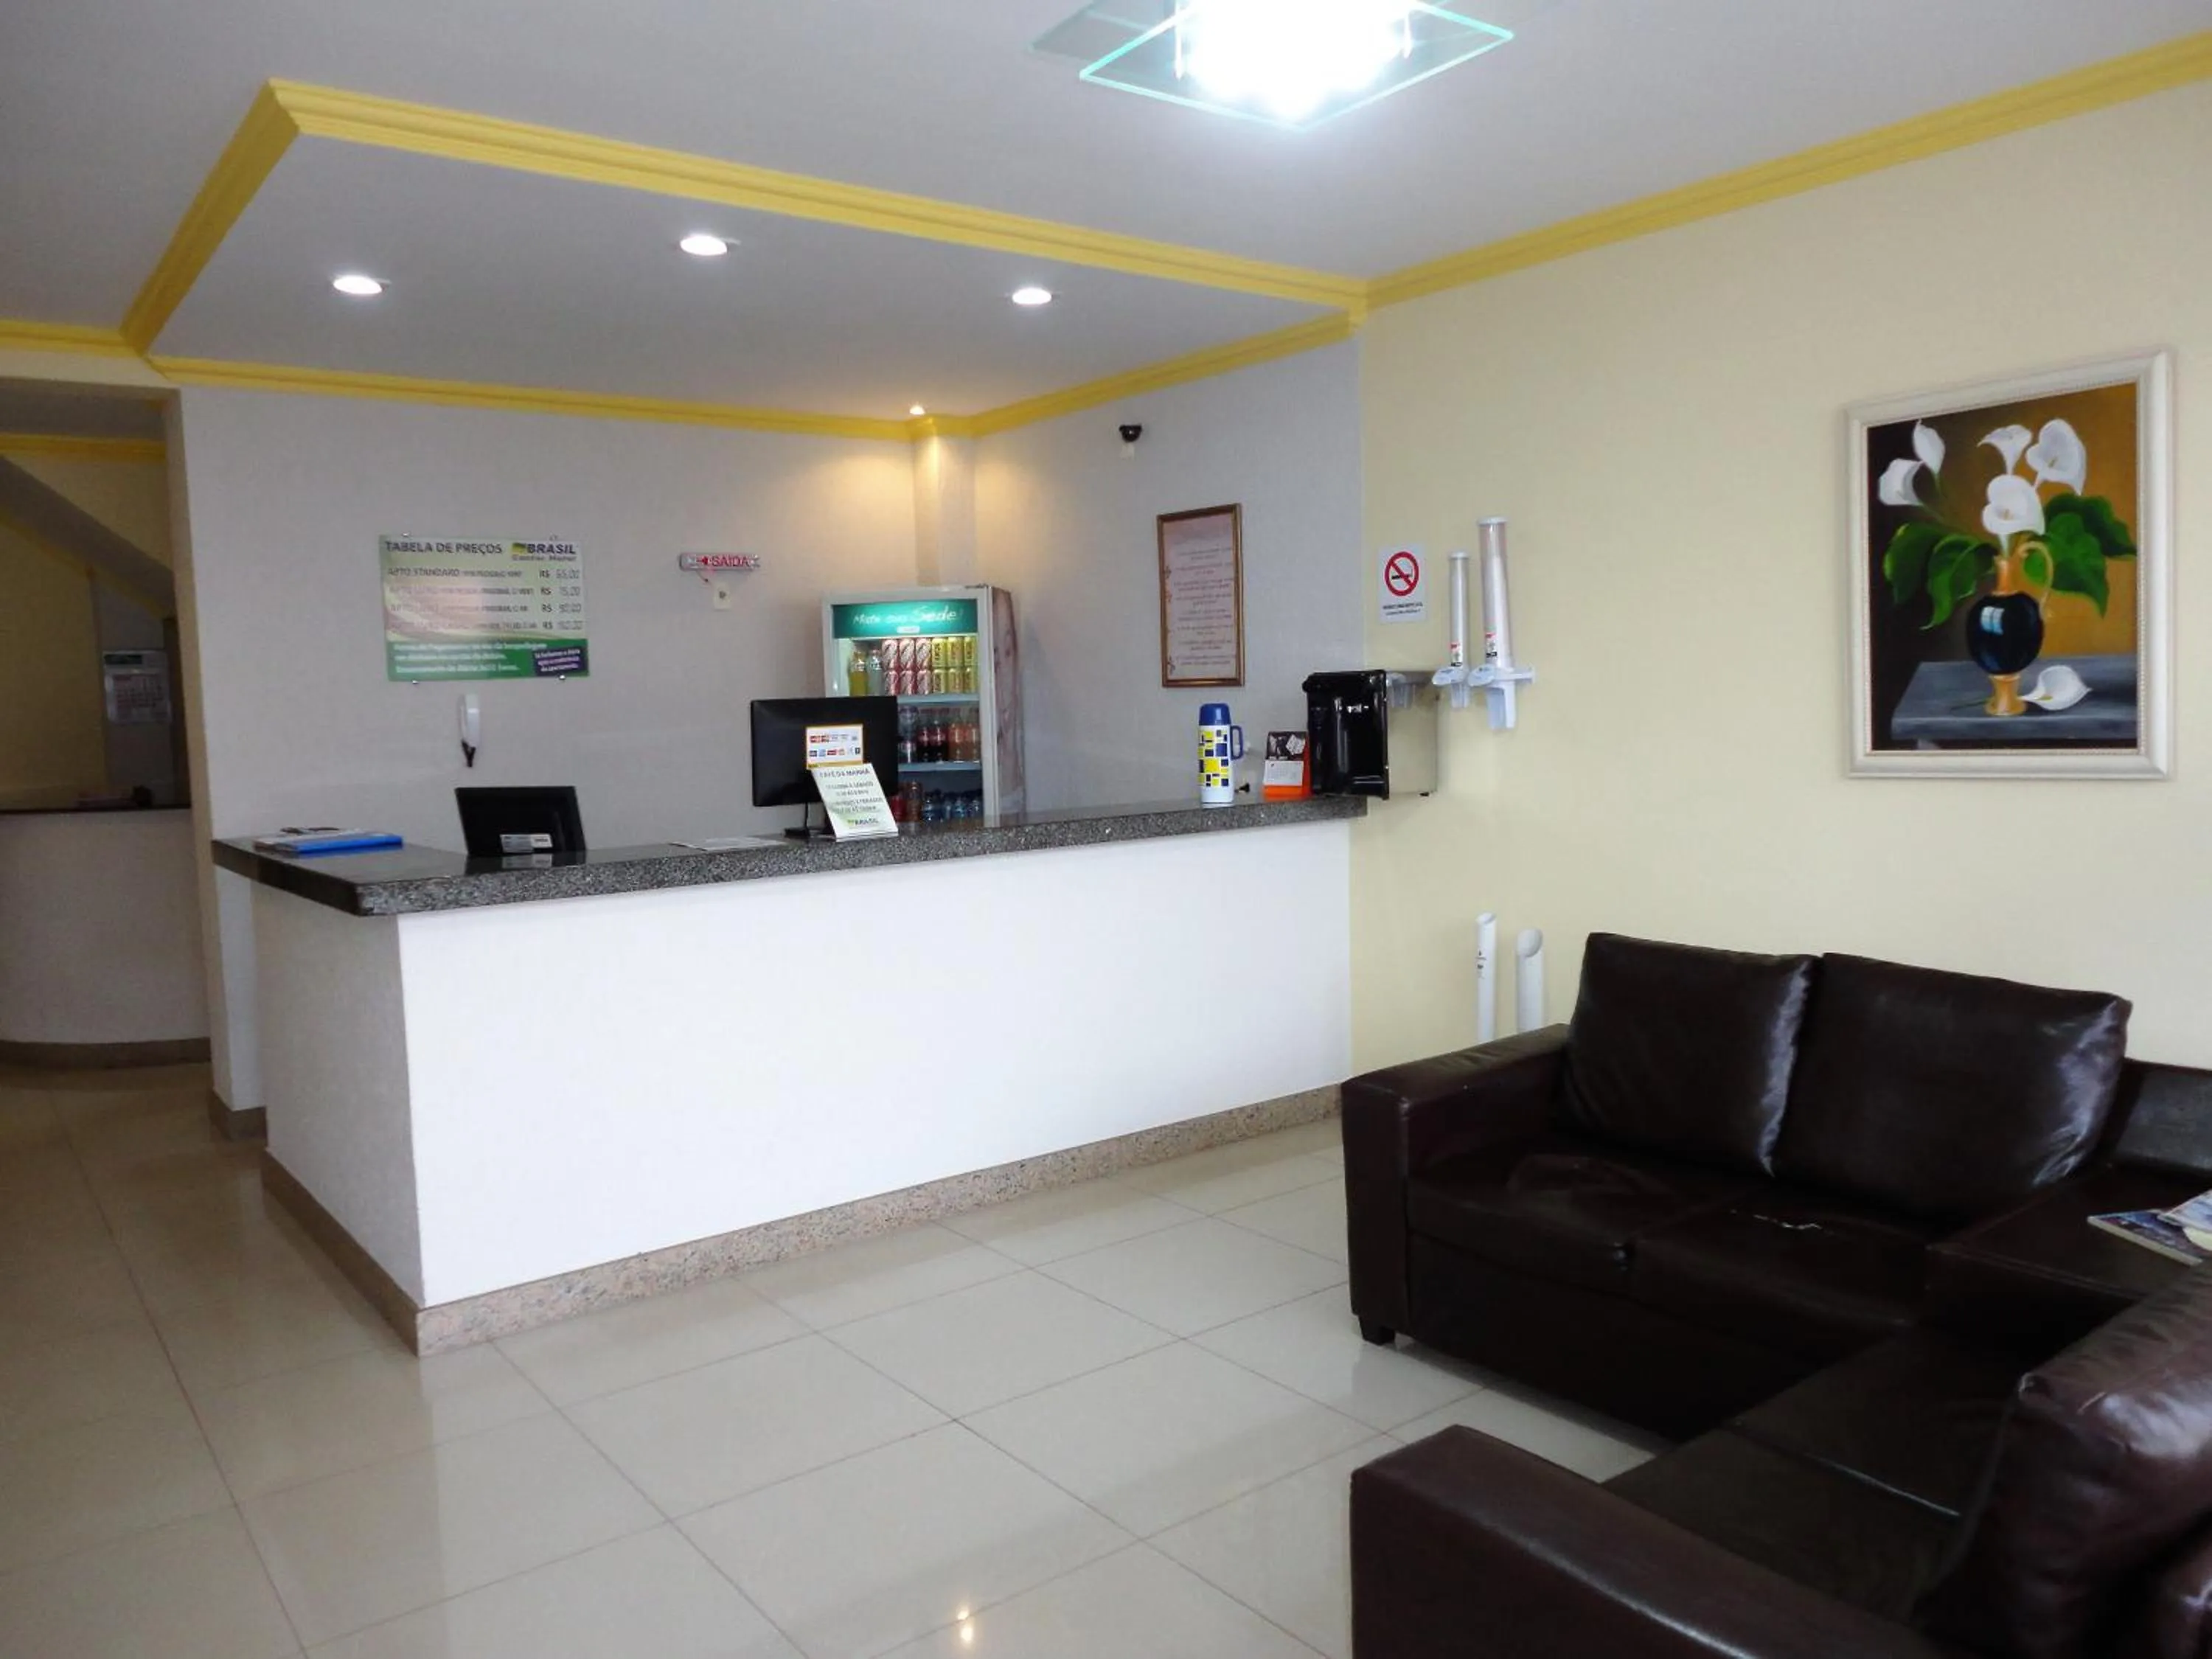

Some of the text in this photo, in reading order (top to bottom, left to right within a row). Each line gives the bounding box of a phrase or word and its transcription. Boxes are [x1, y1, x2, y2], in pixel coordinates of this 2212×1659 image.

[386, 541, 502, 556] TABELA DE PREÇOS
[527, 543, 576, 554] BRASIL
